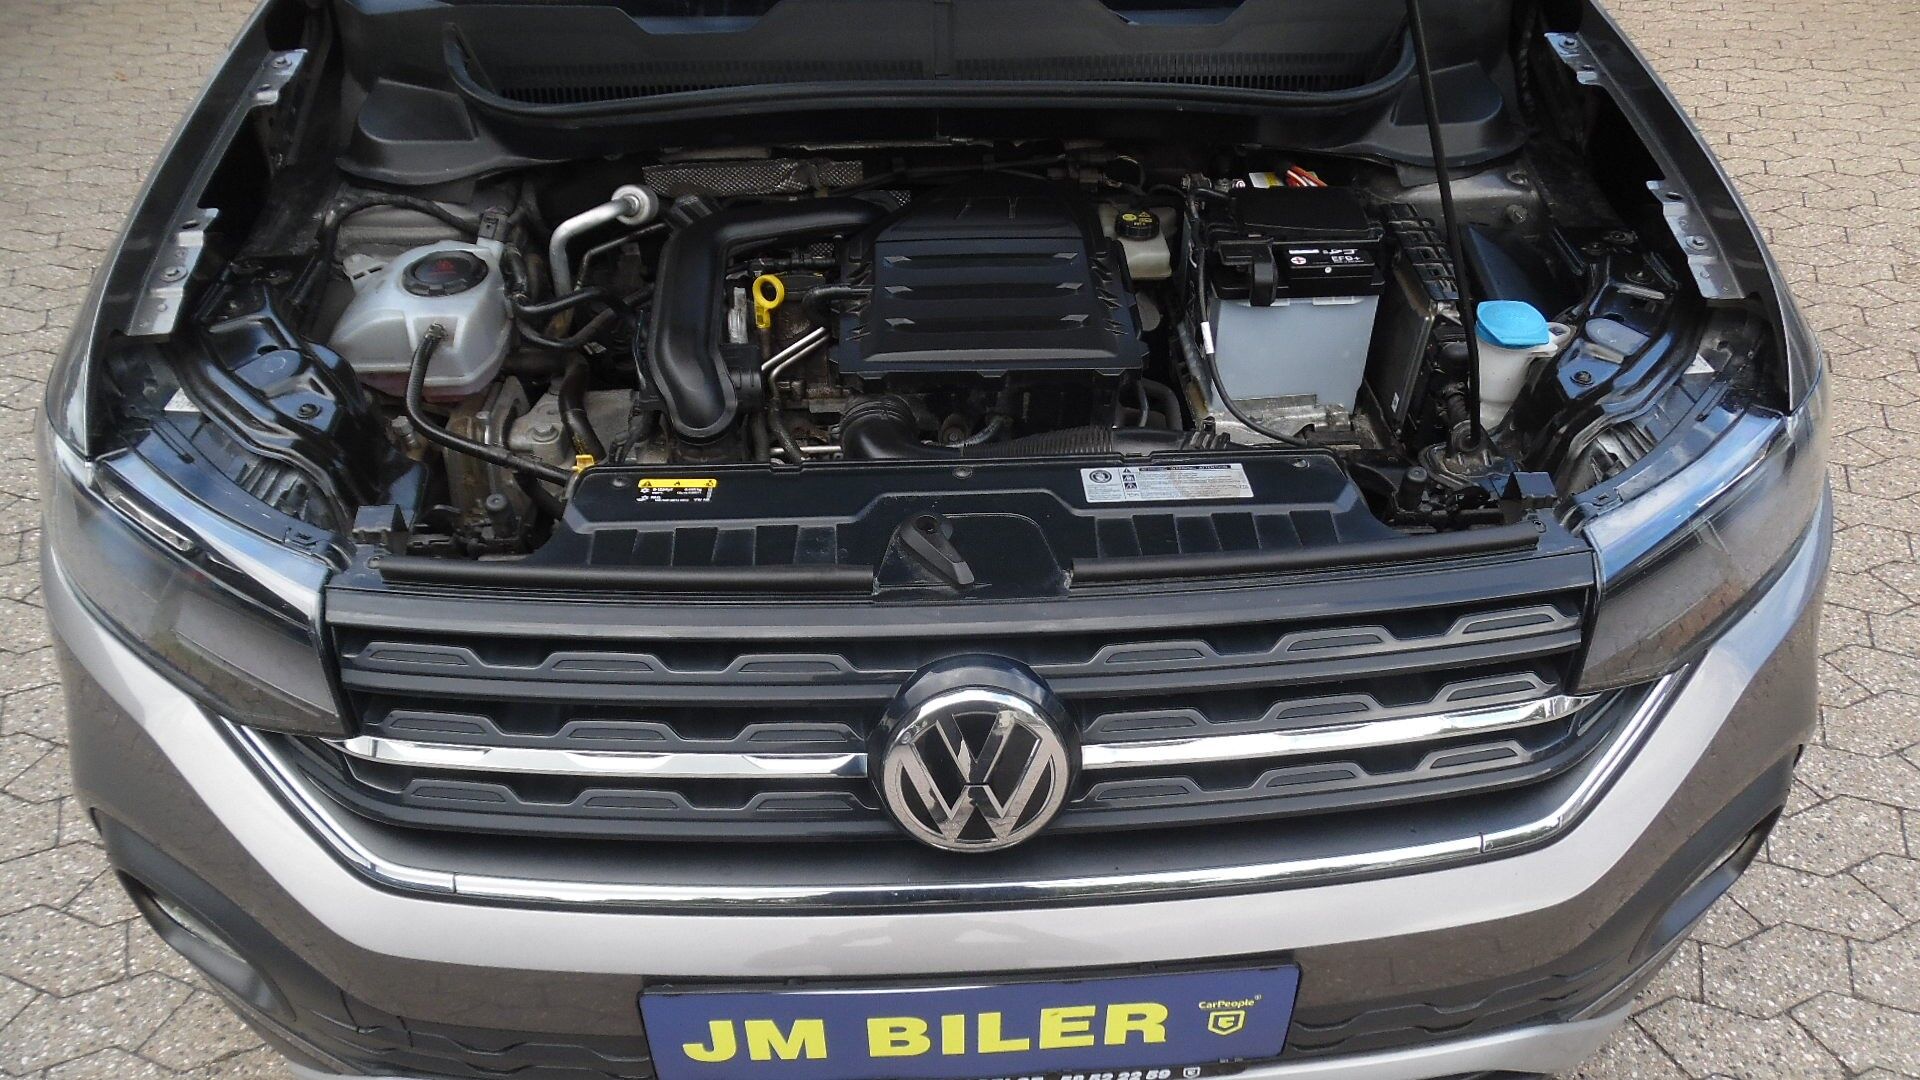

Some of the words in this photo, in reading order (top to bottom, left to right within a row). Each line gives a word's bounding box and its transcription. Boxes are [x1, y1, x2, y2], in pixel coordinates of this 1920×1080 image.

[884, 689, 1069, 852] VW
[682, 1019, 827, 1062] JM
[867, 1002, 1168, 1057] BILER
